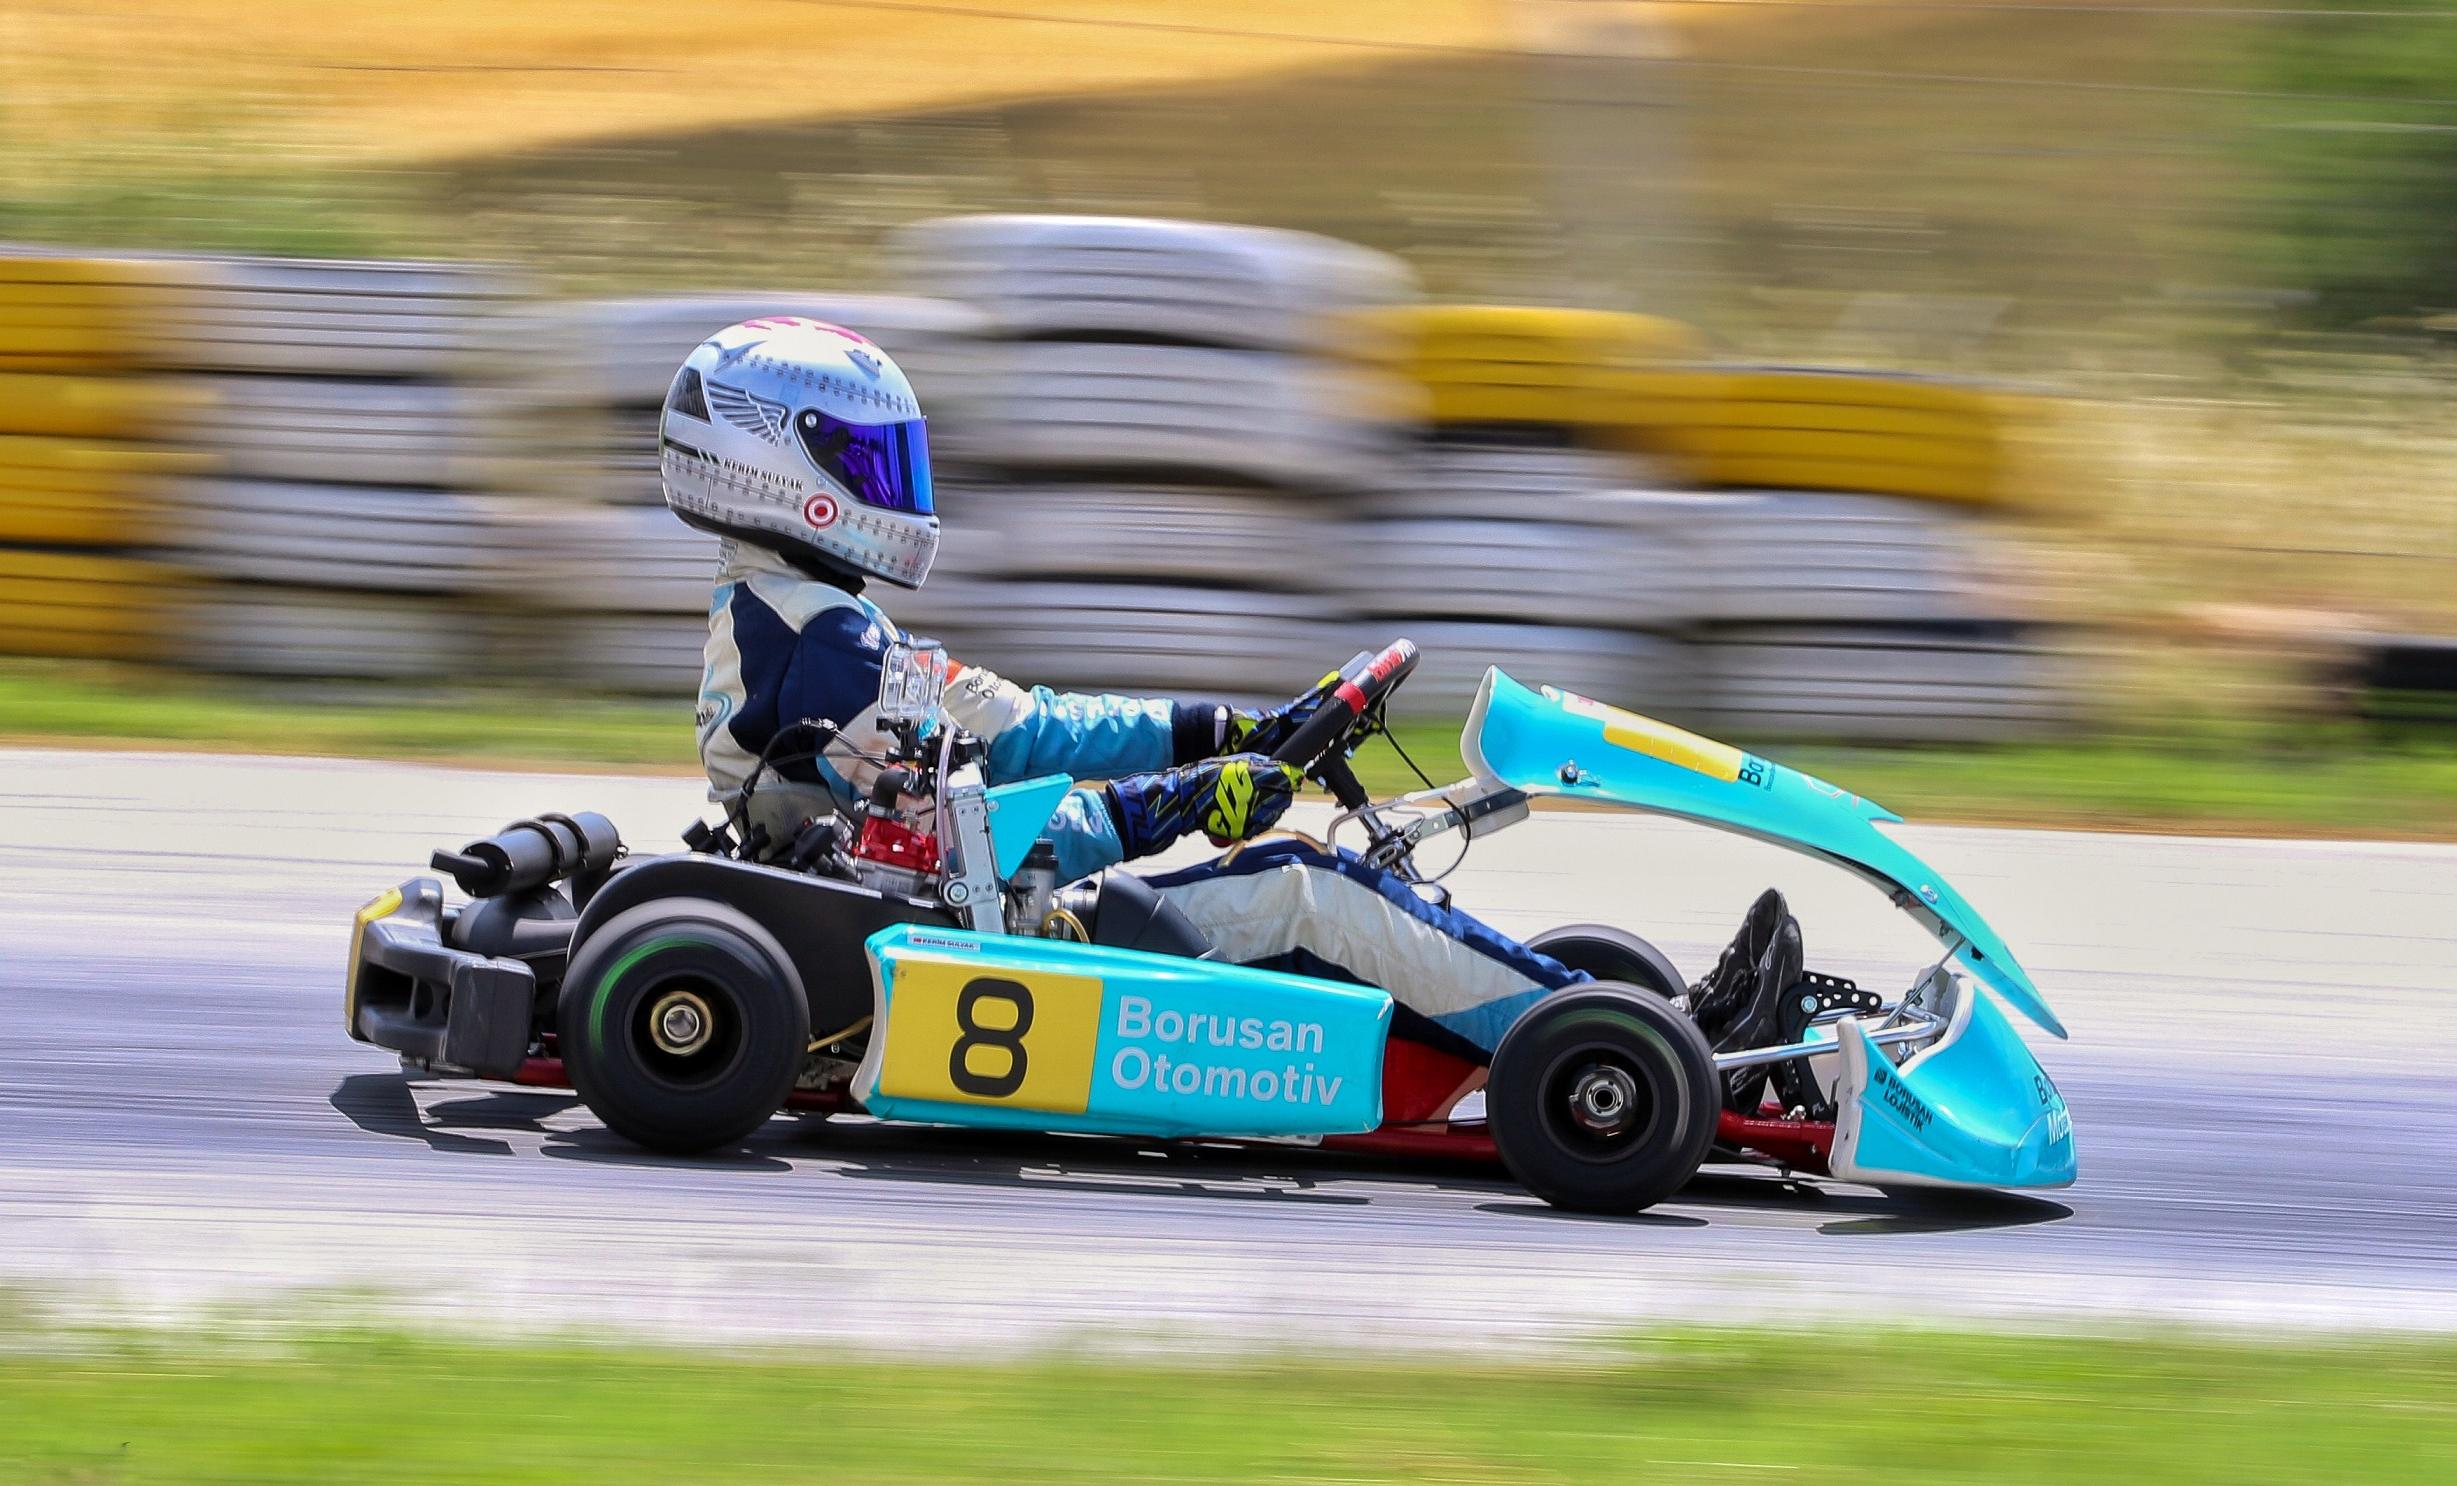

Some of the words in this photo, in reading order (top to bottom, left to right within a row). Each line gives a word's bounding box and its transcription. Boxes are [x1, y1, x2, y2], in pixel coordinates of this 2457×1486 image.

[949, 977, 1034, 1098] 8
[1117, 995, 1323, 1053] Borusan
[1112, 1047, 1342, 1105] Otomotiv
[1889, 1077, 1933, 1125] BORUSAN
